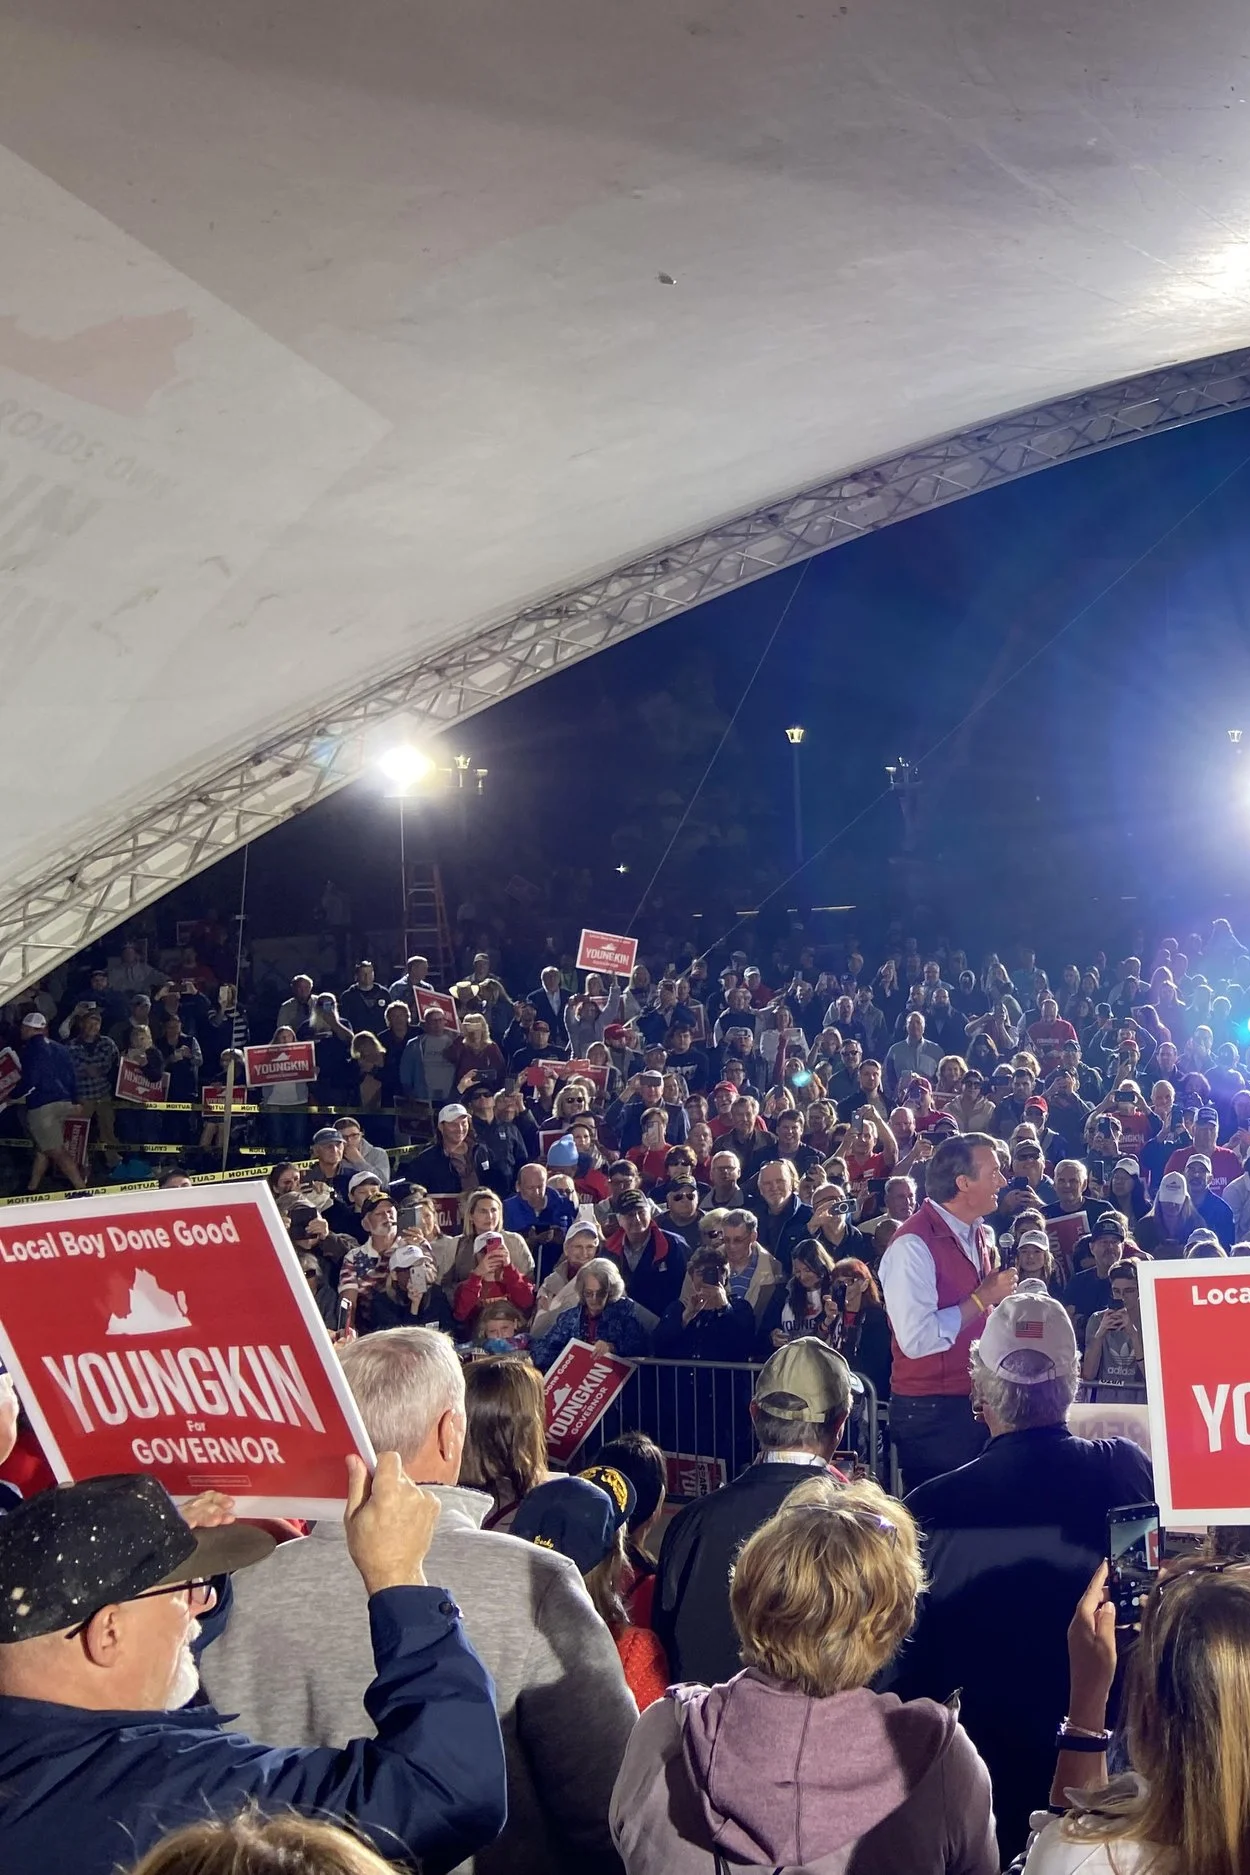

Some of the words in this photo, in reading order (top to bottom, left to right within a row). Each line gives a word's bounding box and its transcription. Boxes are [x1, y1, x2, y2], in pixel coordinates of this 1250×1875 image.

[254, 1060, 309, 1076] YOUNGKIN
[1, 1231, 60, 1263] Local
[59, 1227, 106, 1259] Boy
[108, 1220, 171, 1252] Done
[173, 1216, 240, 1247] Good
[558, 1354, 575, 1375] Good
[41, 1345, 326, 1433] YOUNGKIN
[545, 1362, 613, 1445] YOUNGKIN
[186, 1420, 206, 1433] For
[571, 1386, 608, 1435] GOVERNOR
[131, 1437, 285, 1465] GOVERNOR
